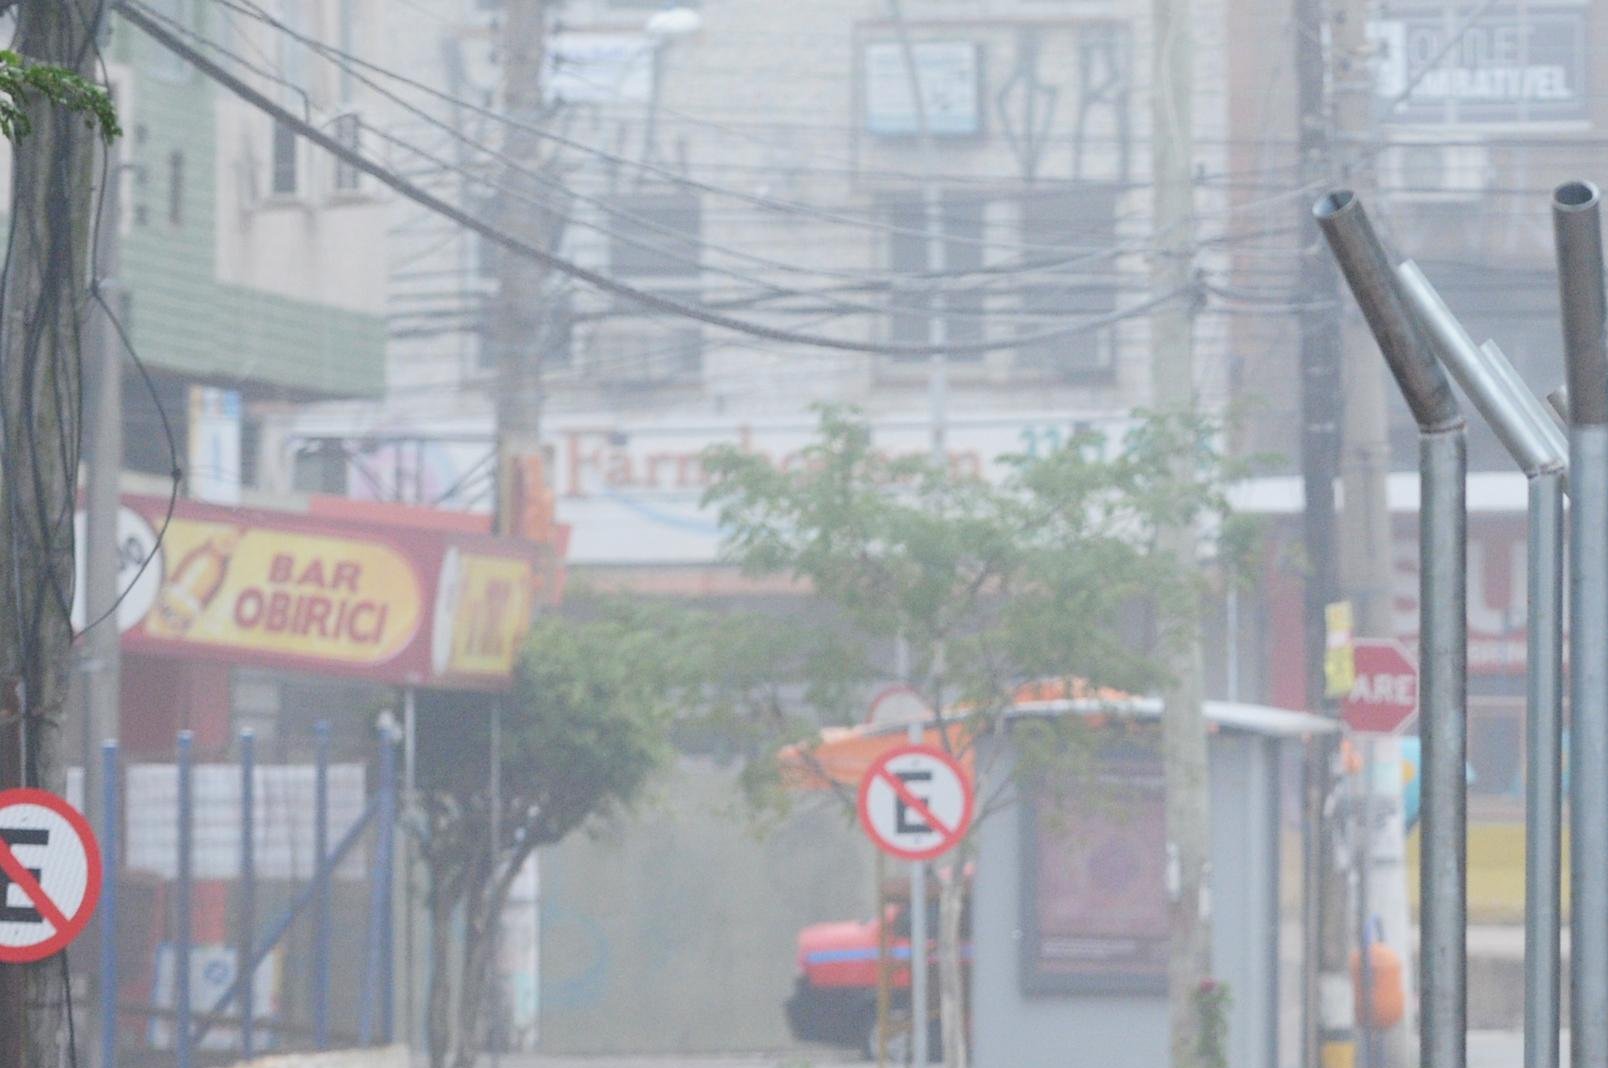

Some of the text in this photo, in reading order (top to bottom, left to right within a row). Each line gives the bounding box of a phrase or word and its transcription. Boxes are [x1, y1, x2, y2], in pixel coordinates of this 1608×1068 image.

[268, 554, 363, 593] BAR
[233, 586, 388, 645] OBIRICI
[1347, 672, 1416, 706] ARE
[895, 771, 932, 834] E
